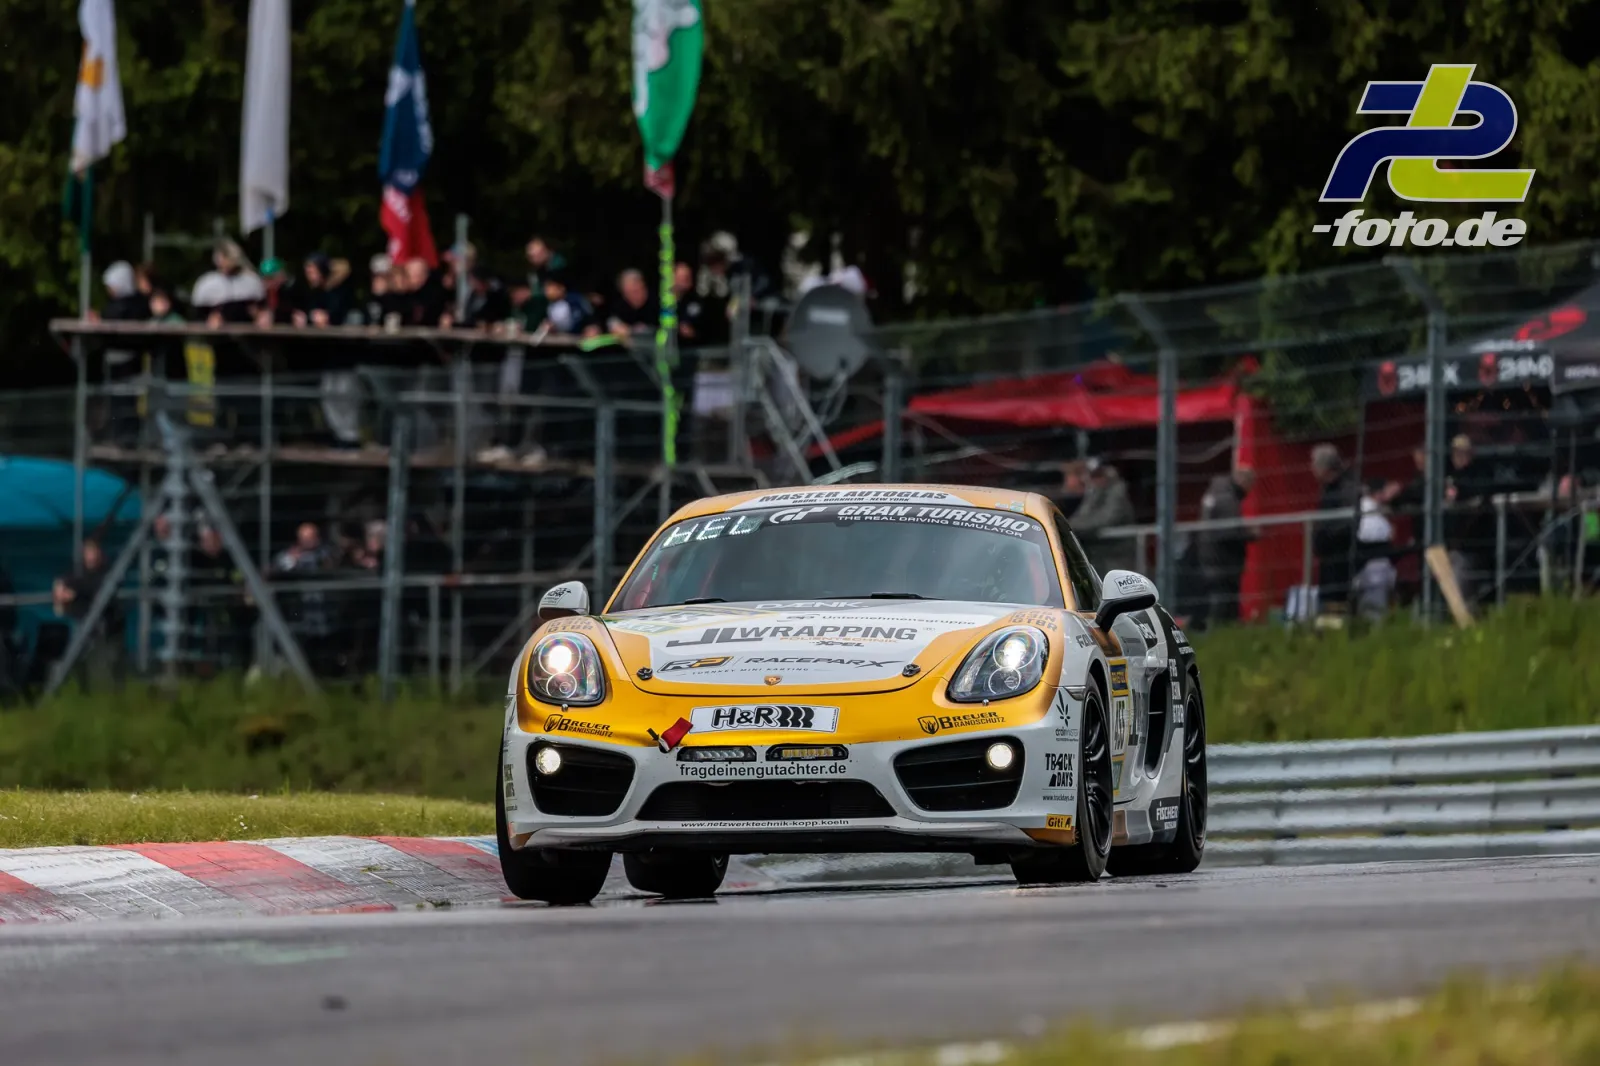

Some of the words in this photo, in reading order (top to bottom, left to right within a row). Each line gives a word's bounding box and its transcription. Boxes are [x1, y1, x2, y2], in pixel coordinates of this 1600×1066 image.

[759, 491, 840, 503] MASTER
[843, 490, 949, 500] AUTOGLAS
[837, 505, 913, 516] GRAN
[662, 515, 752, 547] HEL
[901, 516, 949, 525] DRIVING
[953, 520, 1023, 538] SIMULATOR
[557, 718, 611, 731] BREUER
[711, 706, 777, 728] H&R
[938, 711, 998, 730] BREUER
[1045, 753, 1073, 771] TRACK
[680, 763, 847, 778] fragdeinengutachter.de
[1056, 772, 1073, 787] DAYS
[681, 819, 850, 829] www.netzwerktechnik-kopp.koeln
[1048, 817, 1063, 827] Giti
